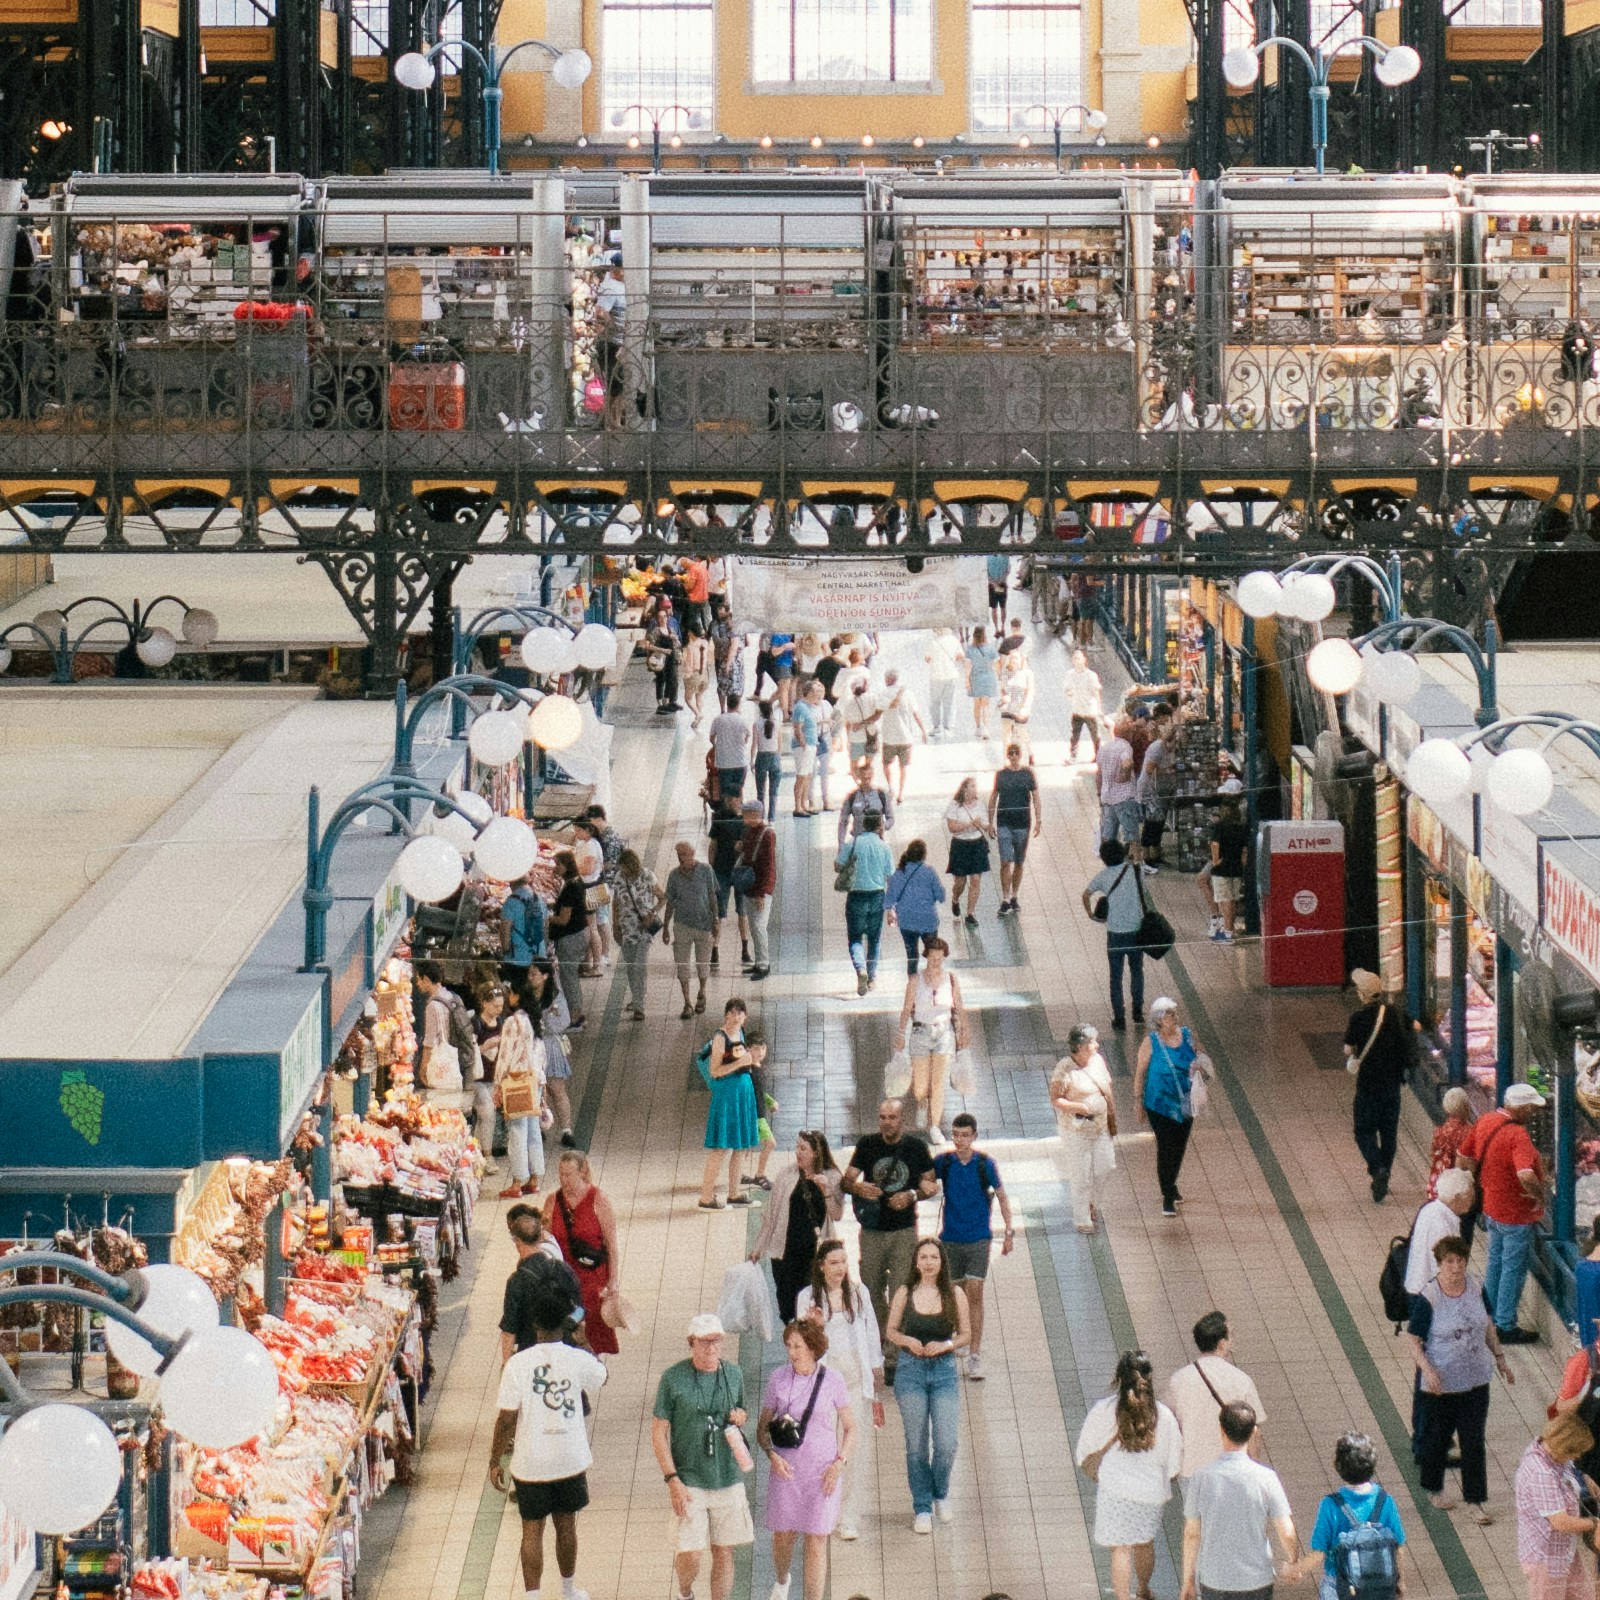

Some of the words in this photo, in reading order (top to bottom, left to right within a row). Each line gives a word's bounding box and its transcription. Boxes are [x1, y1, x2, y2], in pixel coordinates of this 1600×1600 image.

[817, 582, 853, 590] CENTRAL
[856, 581, 888, 589] MARKET
[869, 593, 879, 603] IS
[882, 591, 920, 602] NYITVA
[817, 608, 847, 618] OPEN
[850, 608, 866, 618] ON
[869, 606, 913, 617] SUNDAY
[1287, 838, 1315, 849] ATM
